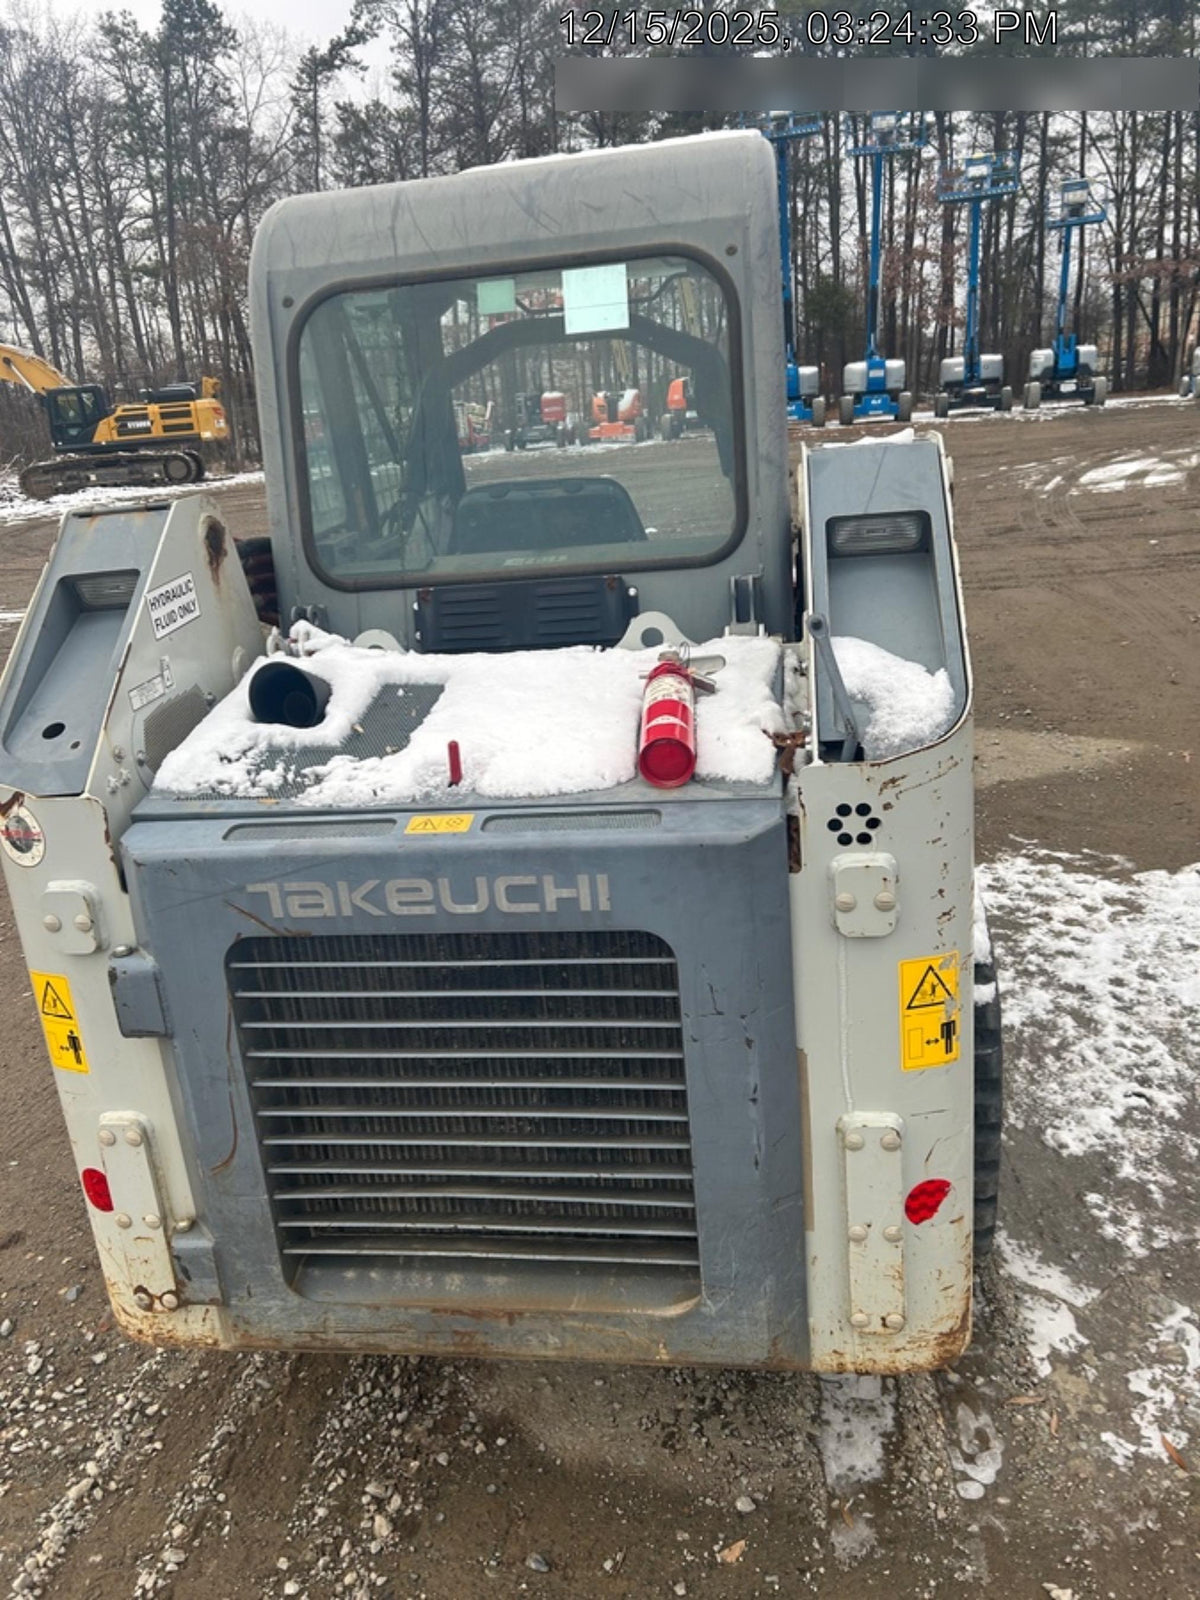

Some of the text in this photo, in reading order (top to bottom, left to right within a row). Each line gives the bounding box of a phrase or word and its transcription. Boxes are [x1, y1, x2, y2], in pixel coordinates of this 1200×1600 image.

[149, 579, 193, 611] HYDRAULIC
[154, 598, 196, 631] FLUID ONLY
